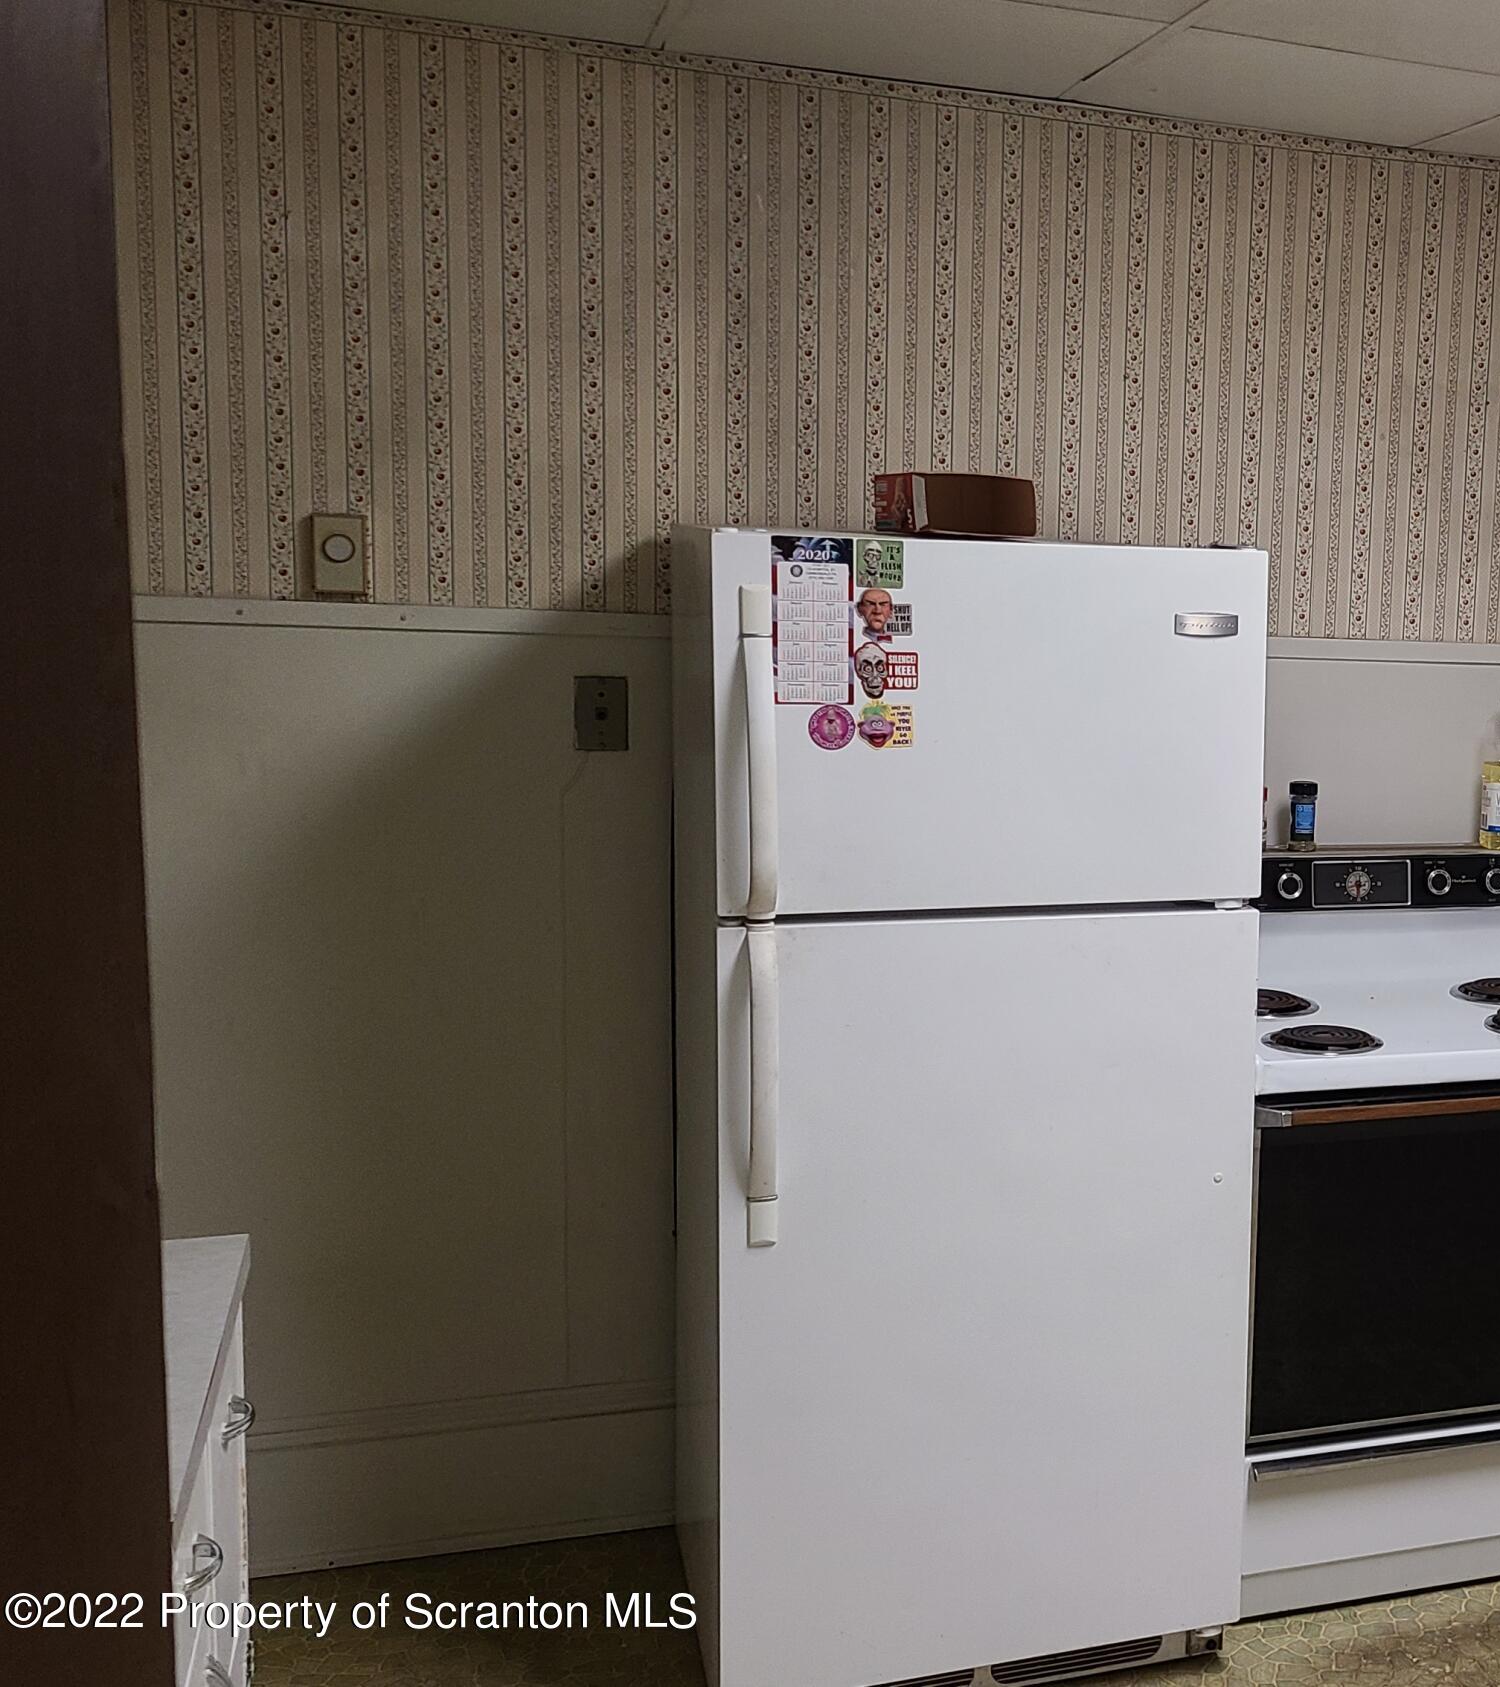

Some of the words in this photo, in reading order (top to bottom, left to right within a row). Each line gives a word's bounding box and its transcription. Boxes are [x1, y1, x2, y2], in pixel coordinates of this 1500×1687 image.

[797, 549, 831, 561] 2020
[881, 562, 902, 571] FLESH
[894, 605, 911, 614] SHUT
[886, 622, 900, 633] HELL
[888, 665, 893, 676] I
[894, 665, 917, 676] KEEL
[886, 676, 917, 688] YOU!
